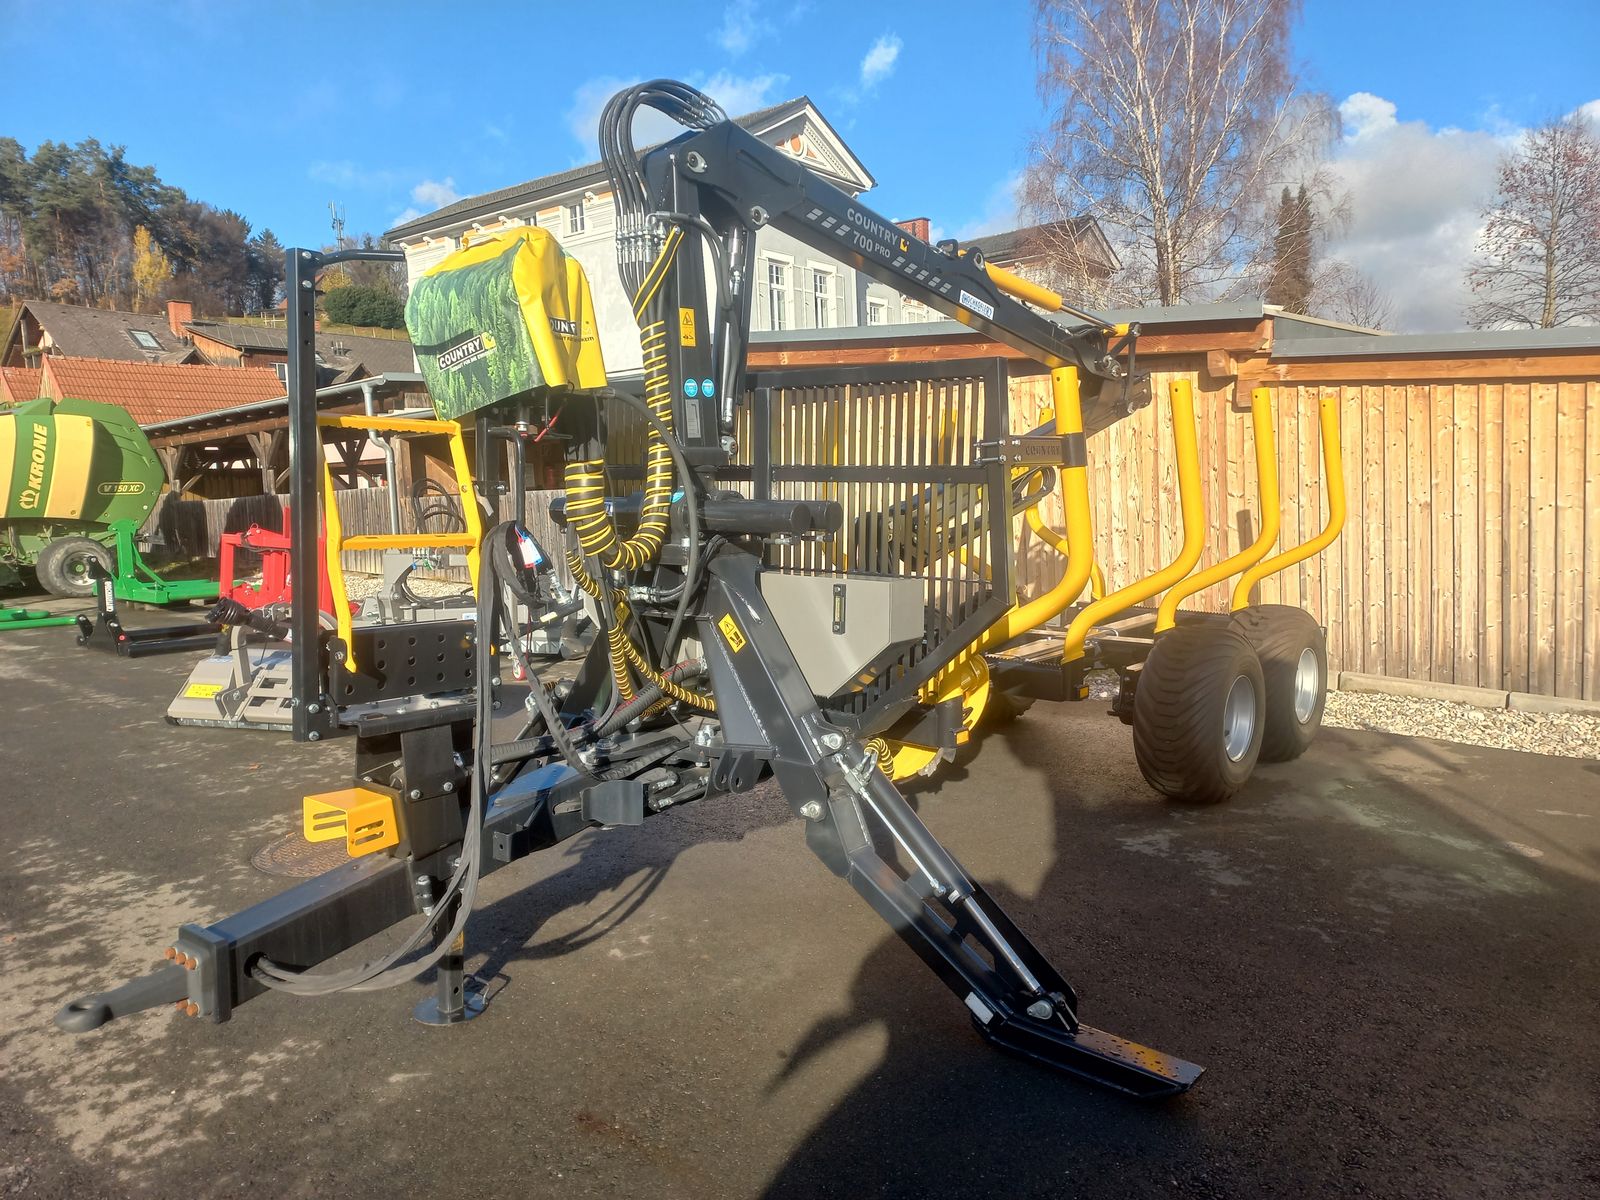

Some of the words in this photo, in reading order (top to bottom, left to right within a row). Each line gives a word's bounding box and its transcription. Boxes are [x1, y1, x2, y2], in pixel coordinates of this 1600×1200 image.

[847, 207, 898, 246] COUNTRY
[853, 229, 873, 252] 700
[874, 243, 891, 258] PRO
[439, 338, 481, 369] COUNTRY
[28, 423, 48, 491] KRONE
[1025, 445, 1060, 456] COUNTRY
[113, 484, 128, 493] 150
[128, 484, 141, 492] XC
